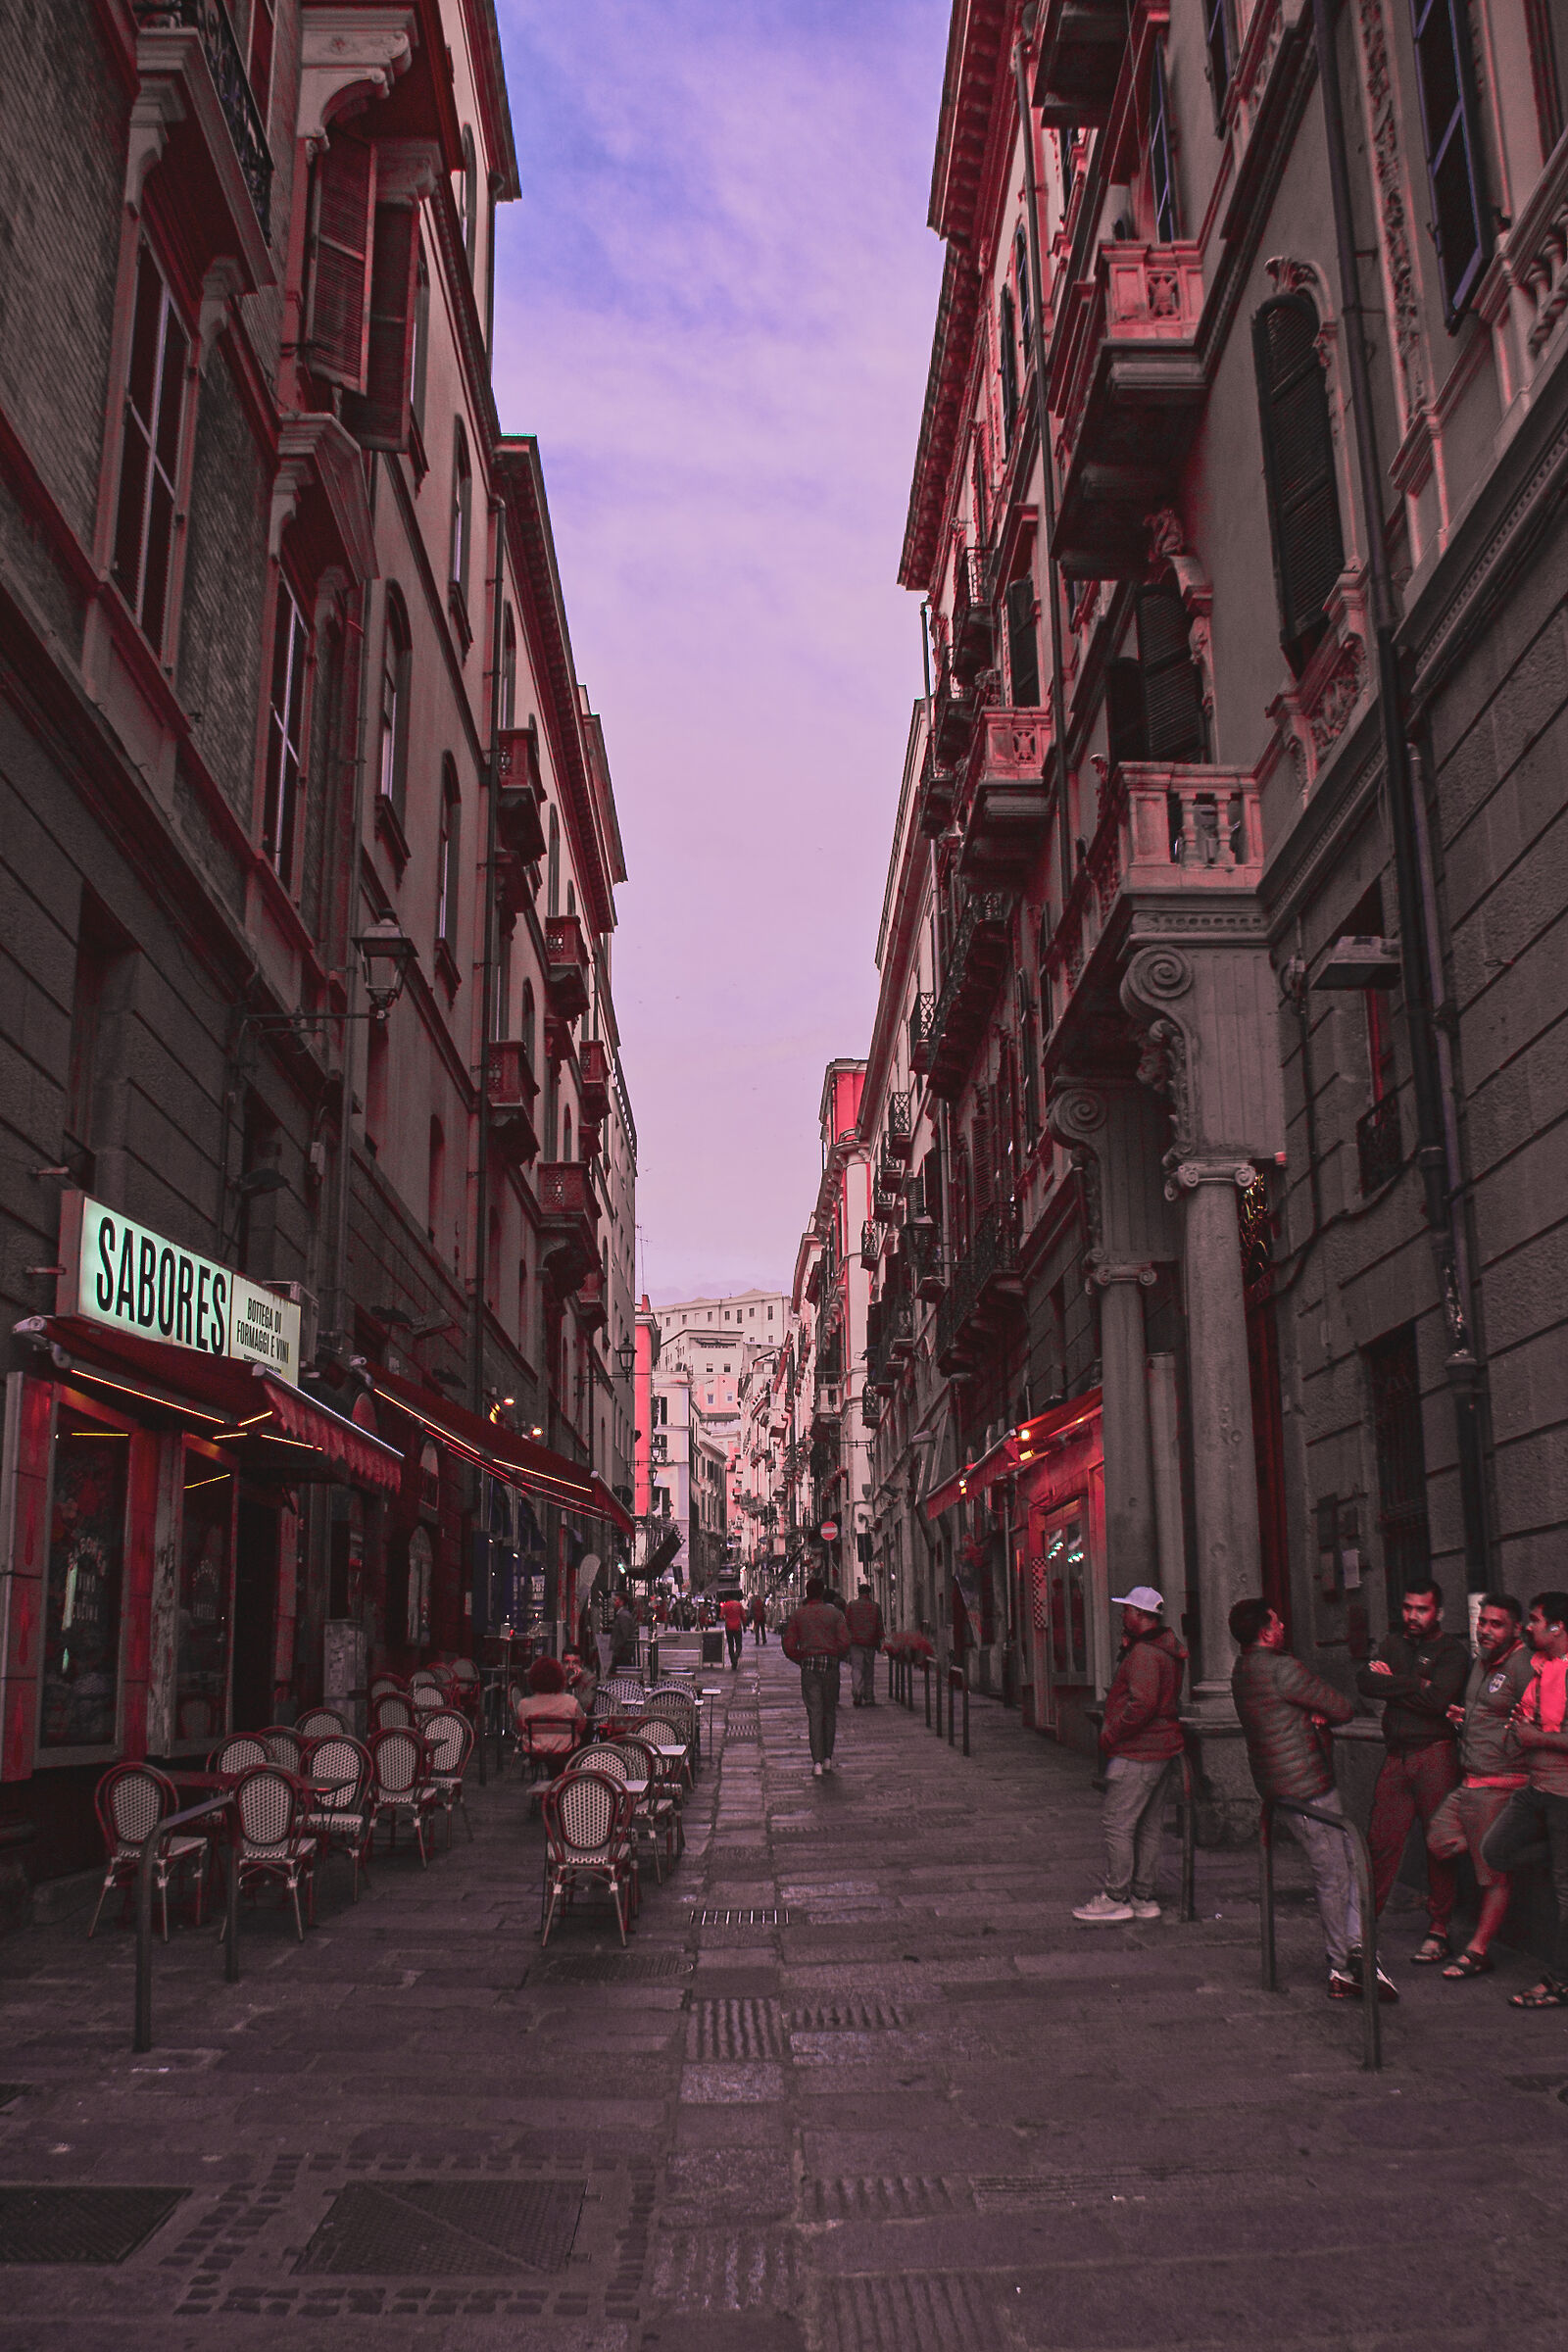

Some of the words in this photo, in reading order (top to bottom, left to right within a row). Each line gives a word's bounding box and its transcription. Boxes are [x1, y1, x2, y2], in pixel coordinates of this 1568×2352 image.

[96, 1216, 226, 1356] SABORES
[247, 1297, 273, 1331] BOTTEGA
[274, 1310, 282, 1335] DI
[236, 1319, 270, 1357] FORMAGGI
[270, 1335, 274, 1358] E
[275, 1337, 290, 1364] VINI
